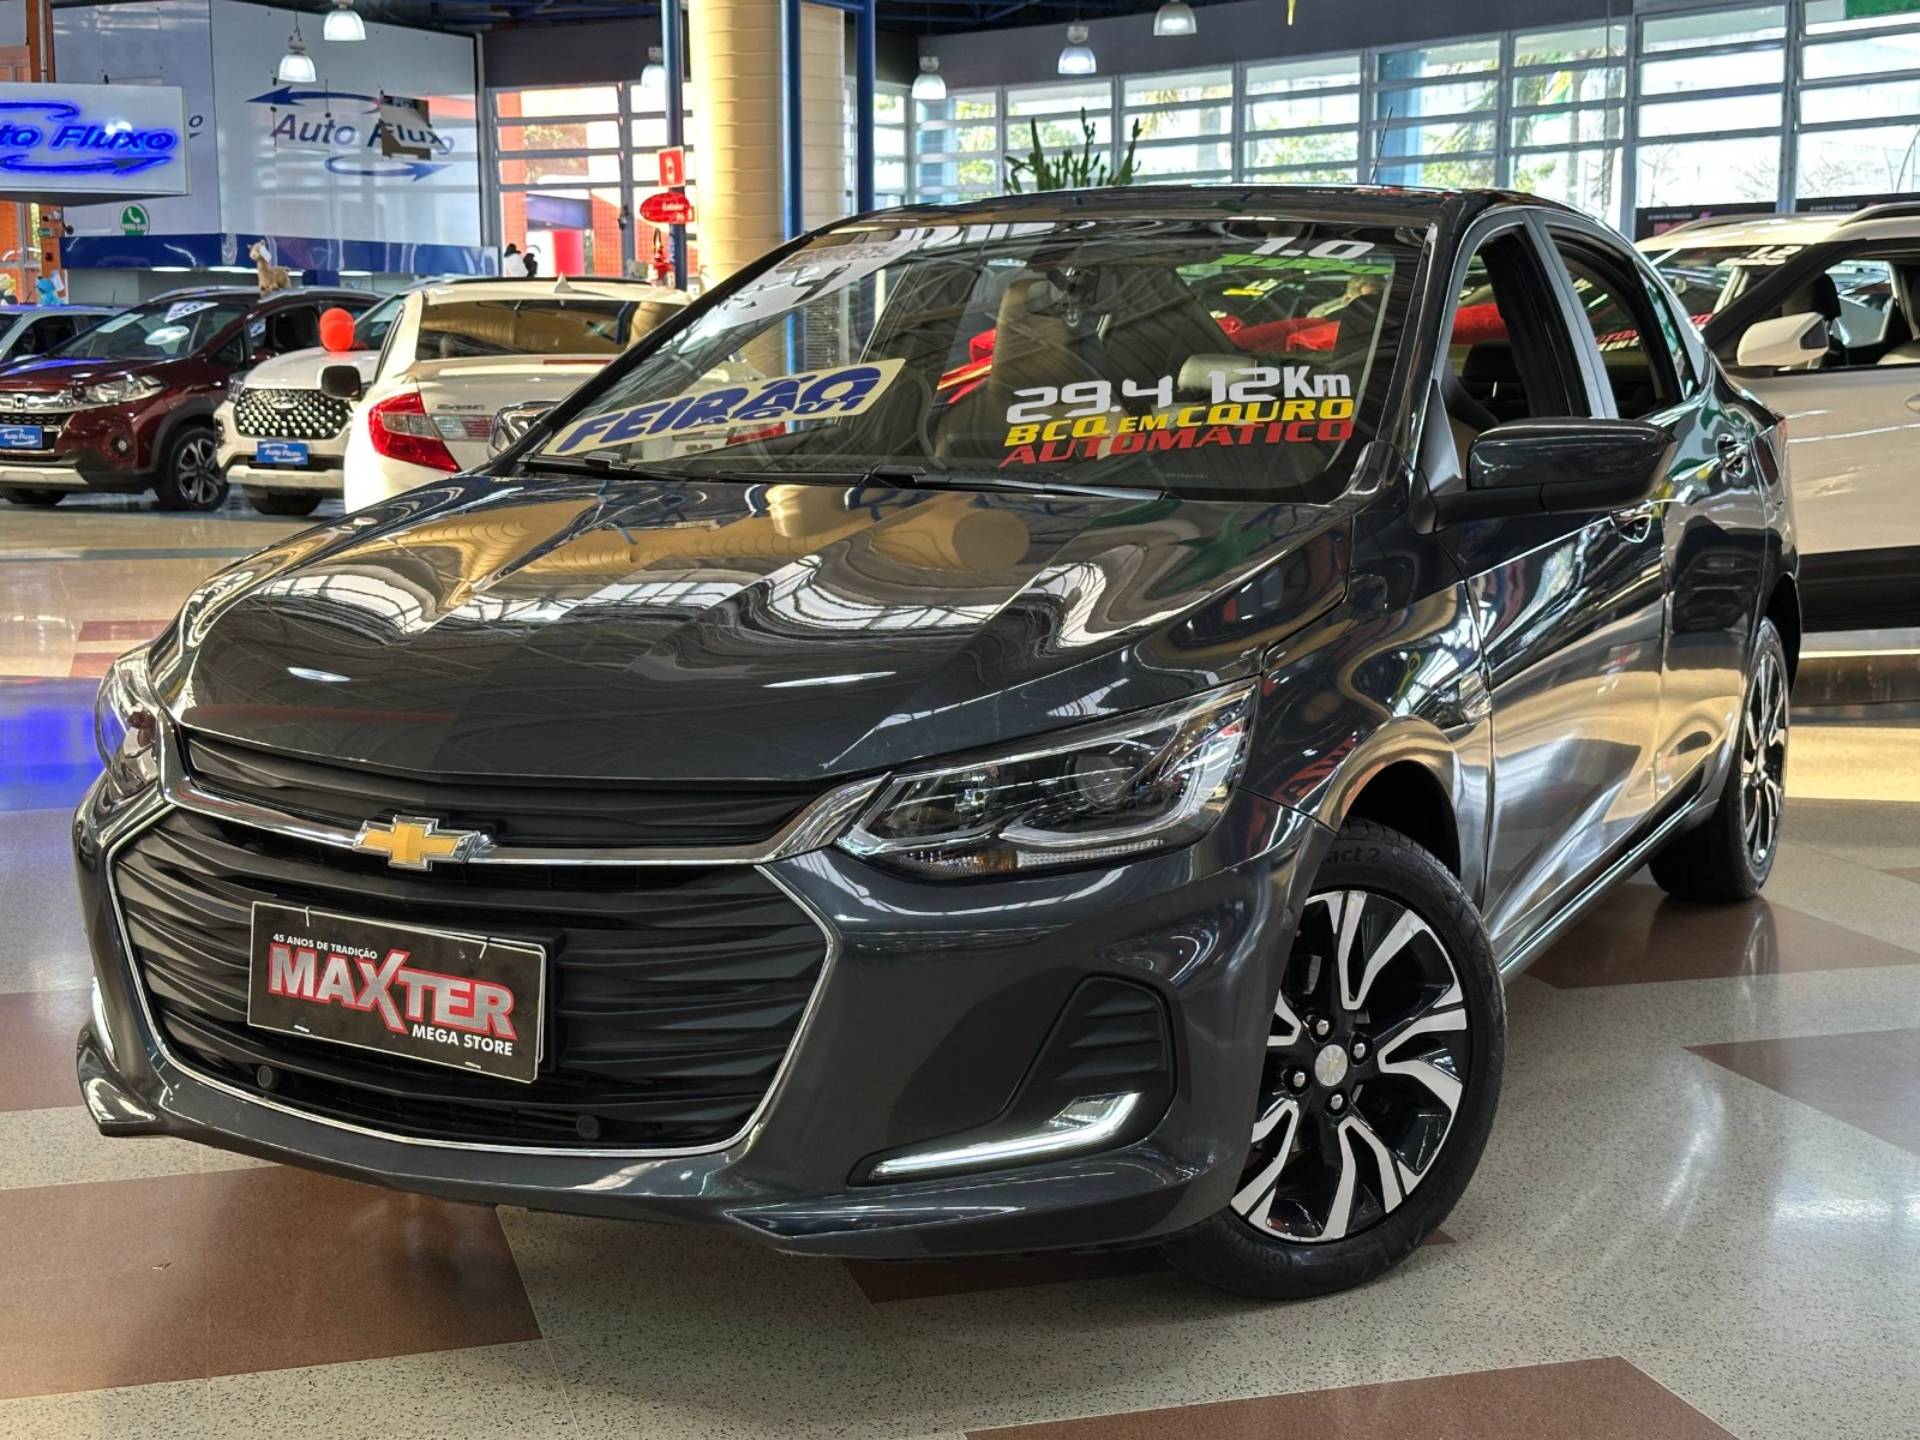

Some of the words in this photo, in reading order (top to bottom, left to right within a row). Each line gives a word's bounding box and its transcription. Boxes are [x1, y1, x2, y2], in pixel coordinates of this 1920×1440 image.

[52, 125, 175, 149] Fluxo
[270, 114, 355, 145] Auto
[1251, 236, 1375, 260] 1.0
[556, 366, 882, 452] FEIRÃO
[1118, 413, 1169, 433] EM
[1176, 398, 1354, 428] COURO
[273, 933, 285, 943] 45
[287, 935, 314, 948] ANOS
[316, 941, 329, 951] DE
[331, 943, 378, 960] TRADIÇÃO
[268, 942, 518, 1040] MAXTER
[412, 1023, 459, 1046] MEGA
[463, 1034, 513, 1056] STORE
